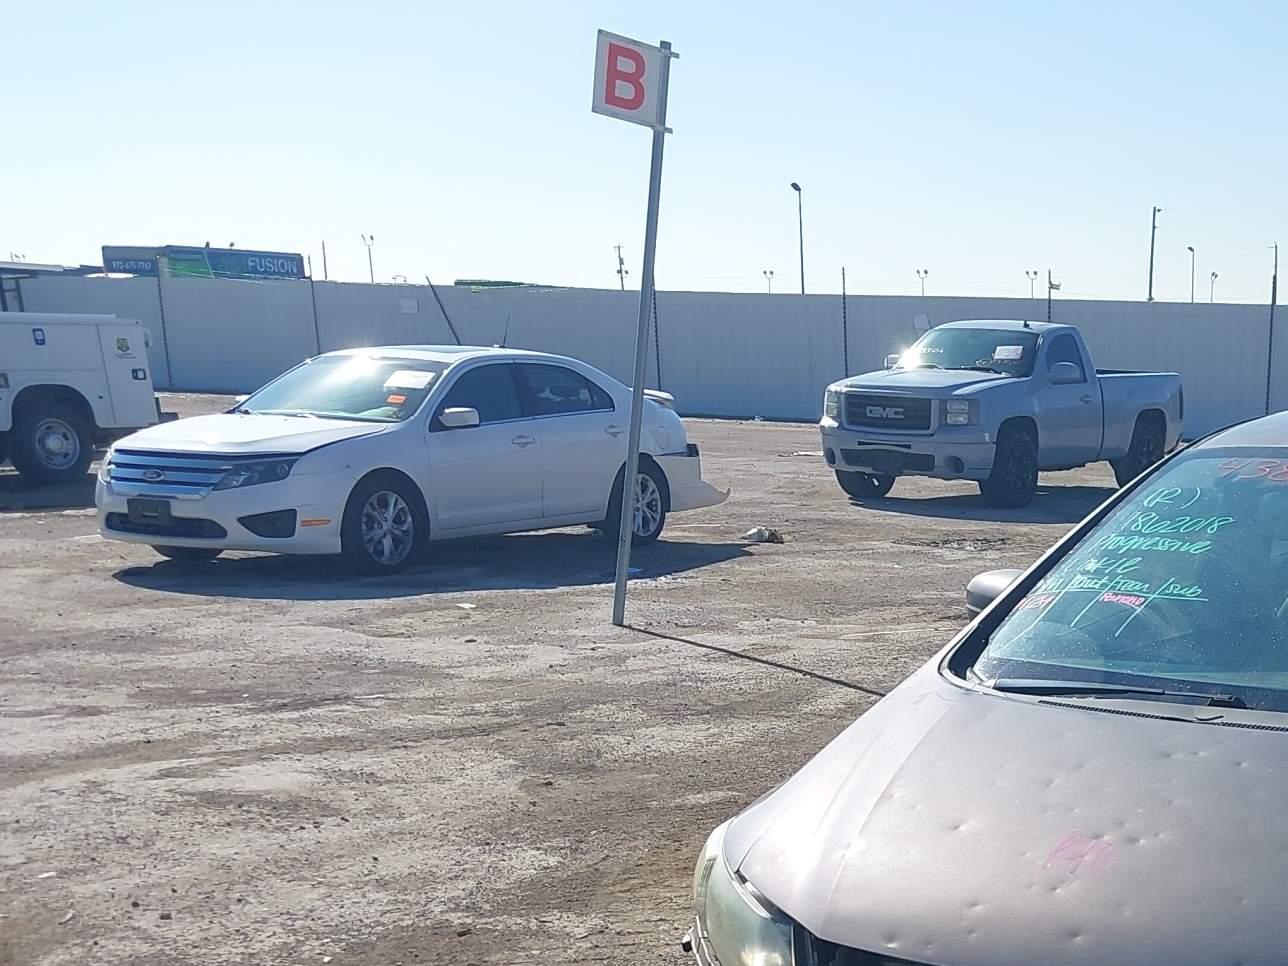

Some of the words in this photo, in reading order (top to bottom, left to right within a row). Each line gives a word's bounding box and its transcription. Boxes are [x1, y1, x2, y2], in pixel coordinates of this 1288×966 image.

[604, 42, 646, 111] B
[247, 256, 298, 274] FUSION
[866, 406, 905, 419] GMC
